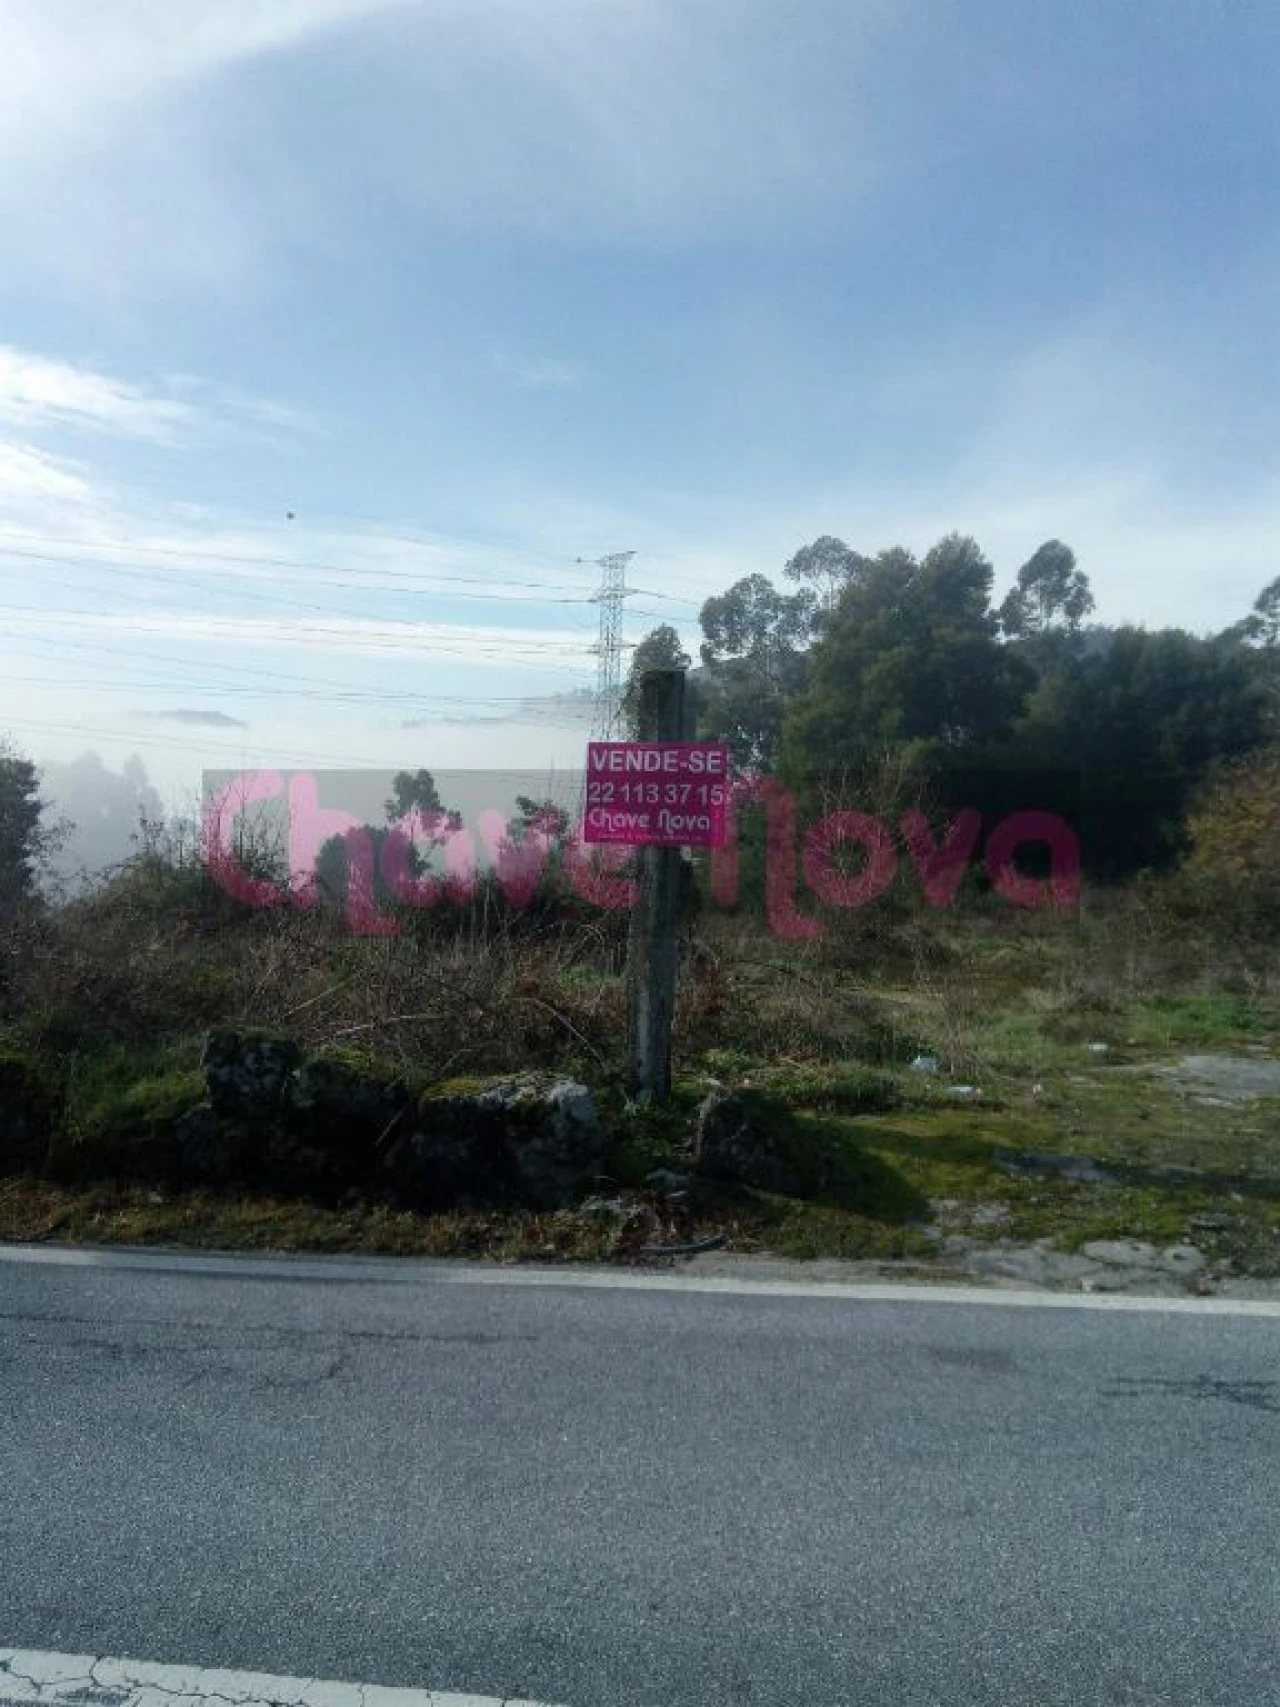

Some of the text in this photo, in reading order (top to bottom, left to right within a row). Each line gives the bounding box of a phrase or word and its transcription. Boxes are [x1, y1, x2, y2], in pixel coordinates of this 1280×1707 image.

[591, 750, 723, 774] VENDE-SE
[588, 782, 723, 805] 22 113 37 15
[588, 807, 650, 832] Chave
